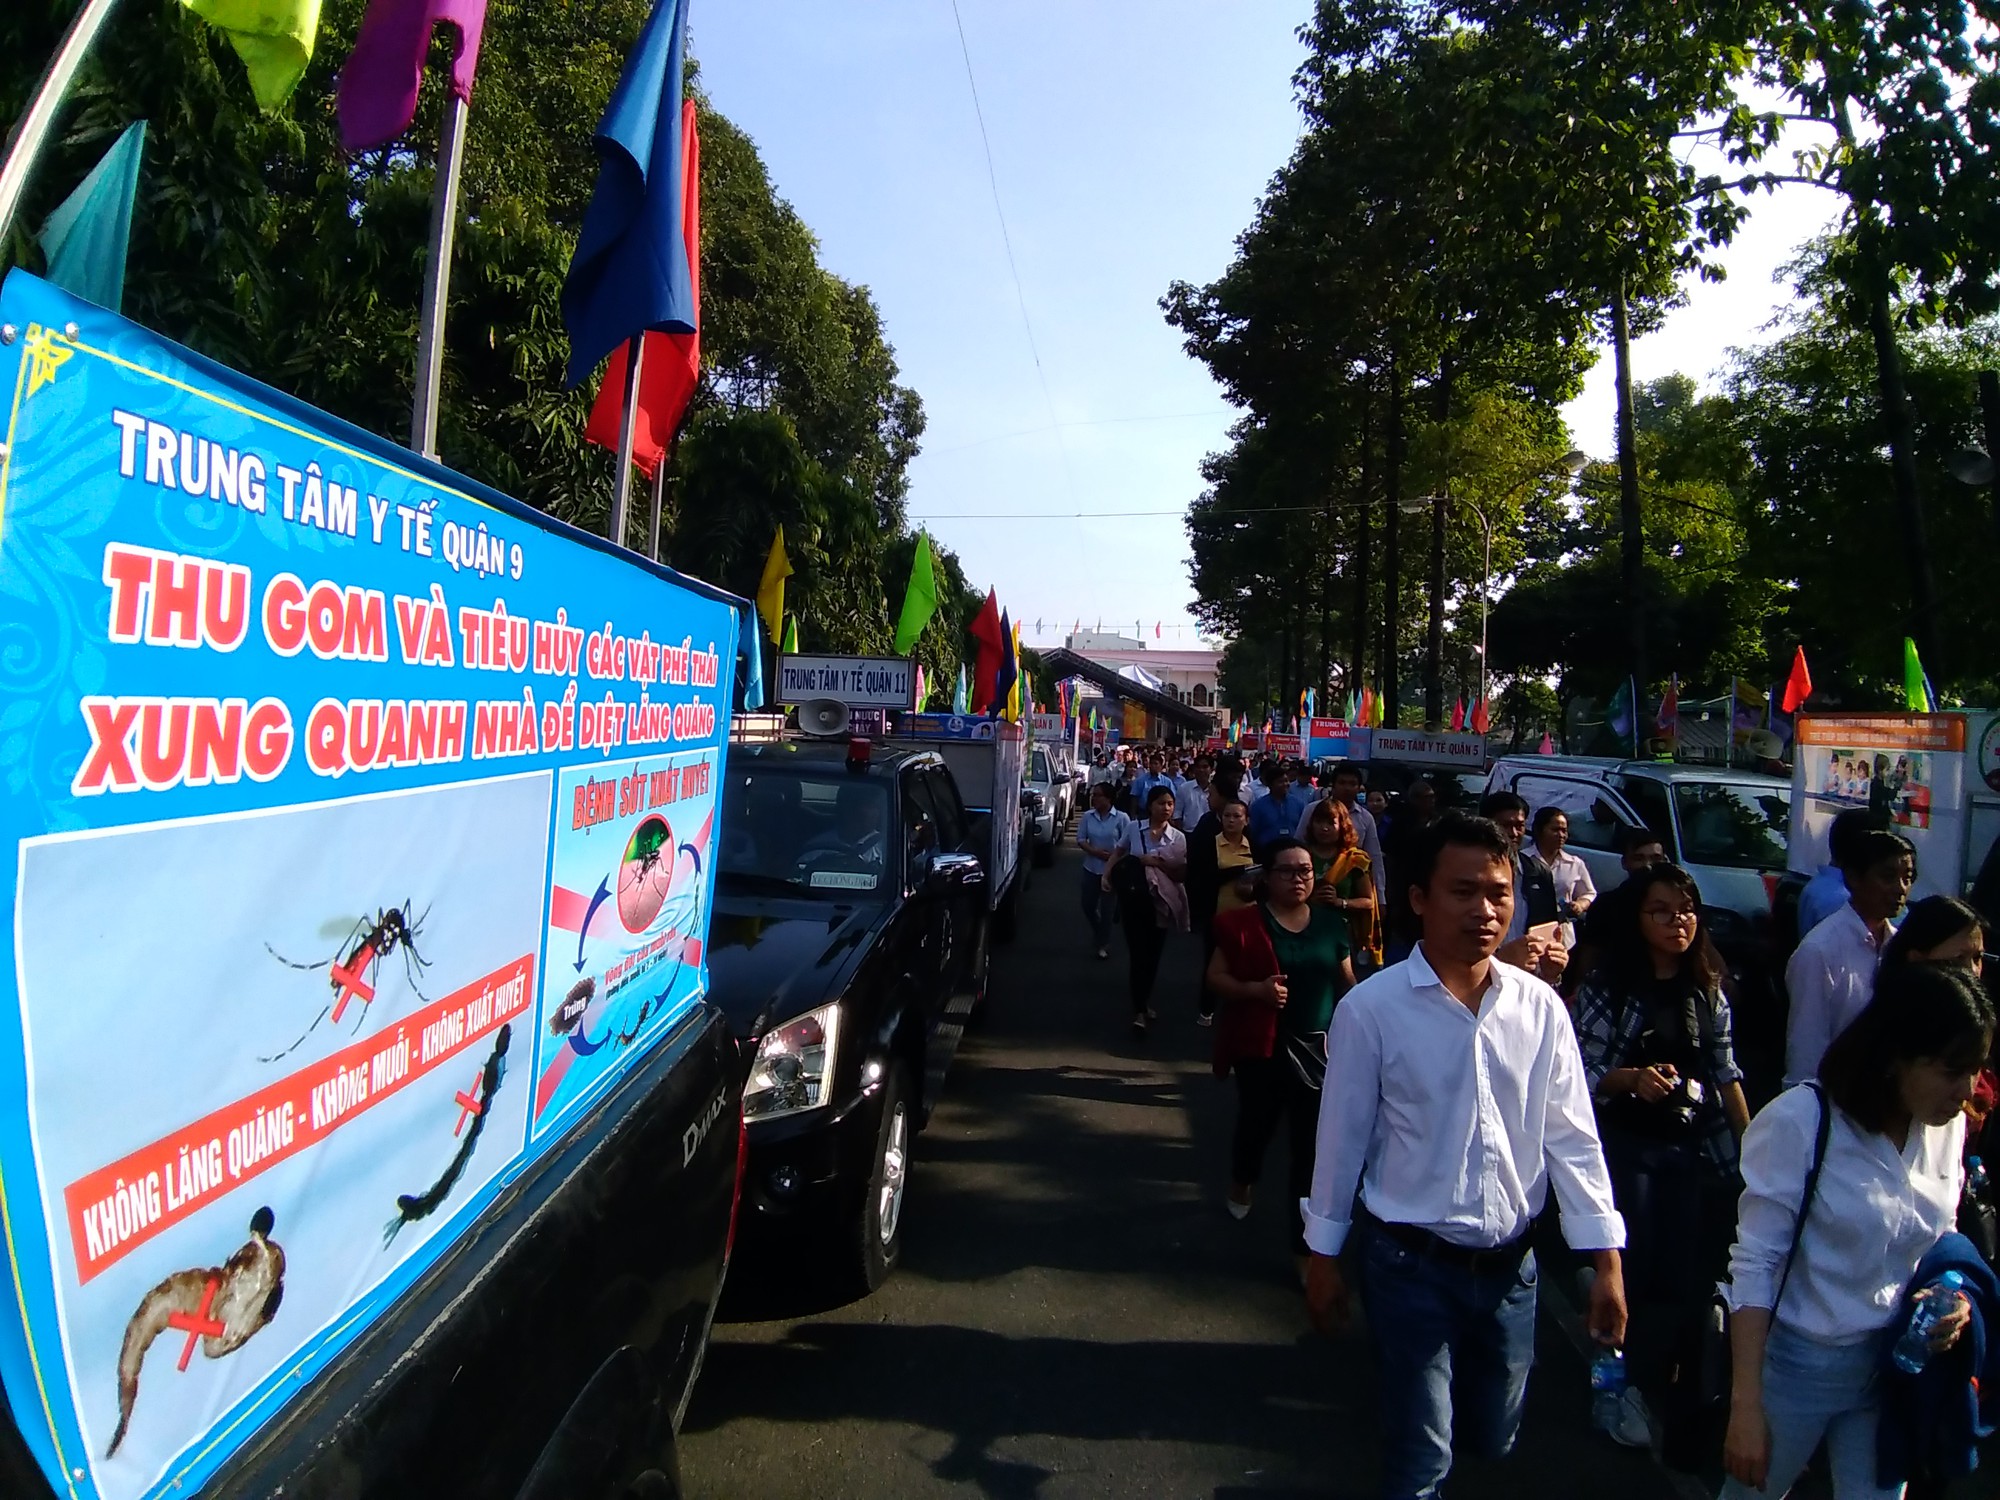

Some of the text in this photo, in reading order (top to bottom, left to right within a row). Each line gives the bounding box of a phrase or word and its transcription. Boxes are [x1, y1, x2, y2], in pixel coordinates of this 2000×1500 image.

[112, 408, 523, 580] TRUNG TÂM Y TẾ QUẬN 9
[102, 542, 719, 691] THU GOM VÀ TIÊU HỦY CÁC VẬT PHẾ THẢI
[784, 662, 906, 697] TRUNG TÂM Y TẾ QUẬN 11
[1315, 721, 1339, 729] TRUNG
[71, 681, 716, 796] XUNG QUANH NHÀ ĐỂ DIỆT LĂNG QUĂNG
[1379, 738, 1406, 750] TRUNG
[1408, 738, 1425, 752] TÂM
[1428, 741, 1434, 752] Y
[1473, 745, 1479, 756] 5
[572, 752, 711, 835] BỆNH SỐT XUẤT HUYẾT
[82, 1170, 162, 1261] KHÔNG
[166, 1138, 222, 1212] LĂNG
[227, 1105, 295, 1179] QUĂNG
[311, 1068, 369, 1131] KHÔNG
[371, 1028, 409, 1095] MUỖI
[421, 1006, 464, 1064] KHÔNG
[465, 981, 494, 1039] XUẤT
[495, 966, 526, 1020] HUYẾT
